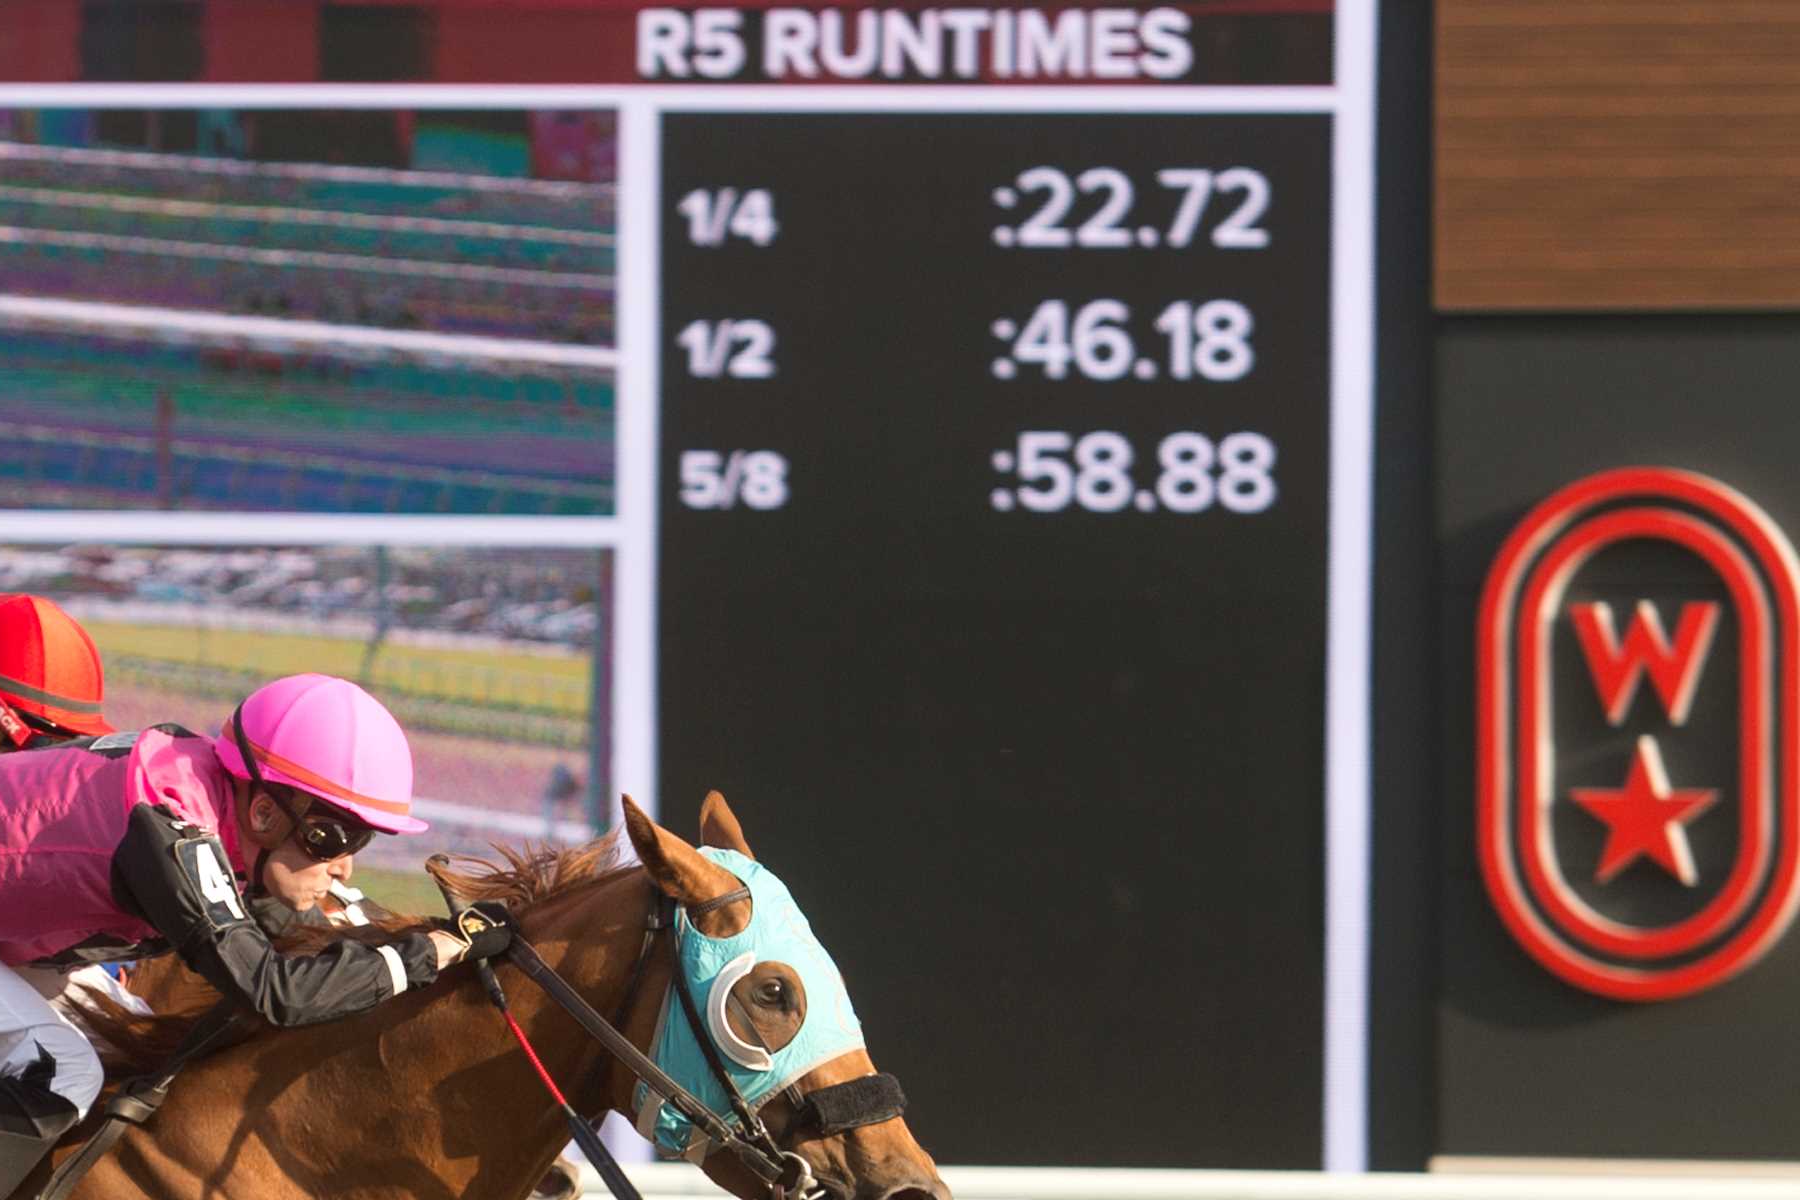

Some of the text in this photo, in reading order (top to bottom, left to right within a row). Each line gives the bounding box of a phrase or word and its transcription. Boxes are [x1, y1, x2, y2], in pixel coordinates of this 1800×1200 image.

[636, 9, 1192, 79] R5 RUNTIMES
[679, 167, 1270, 248] 1/4 :22.72
[678, 299, 1253, 380] 1/2 :46.18
[680, 430, 1276, 513] 5/8 :58.88
[1569, 601, 1719, 725] W
[196, 843, 245, 919] 4
